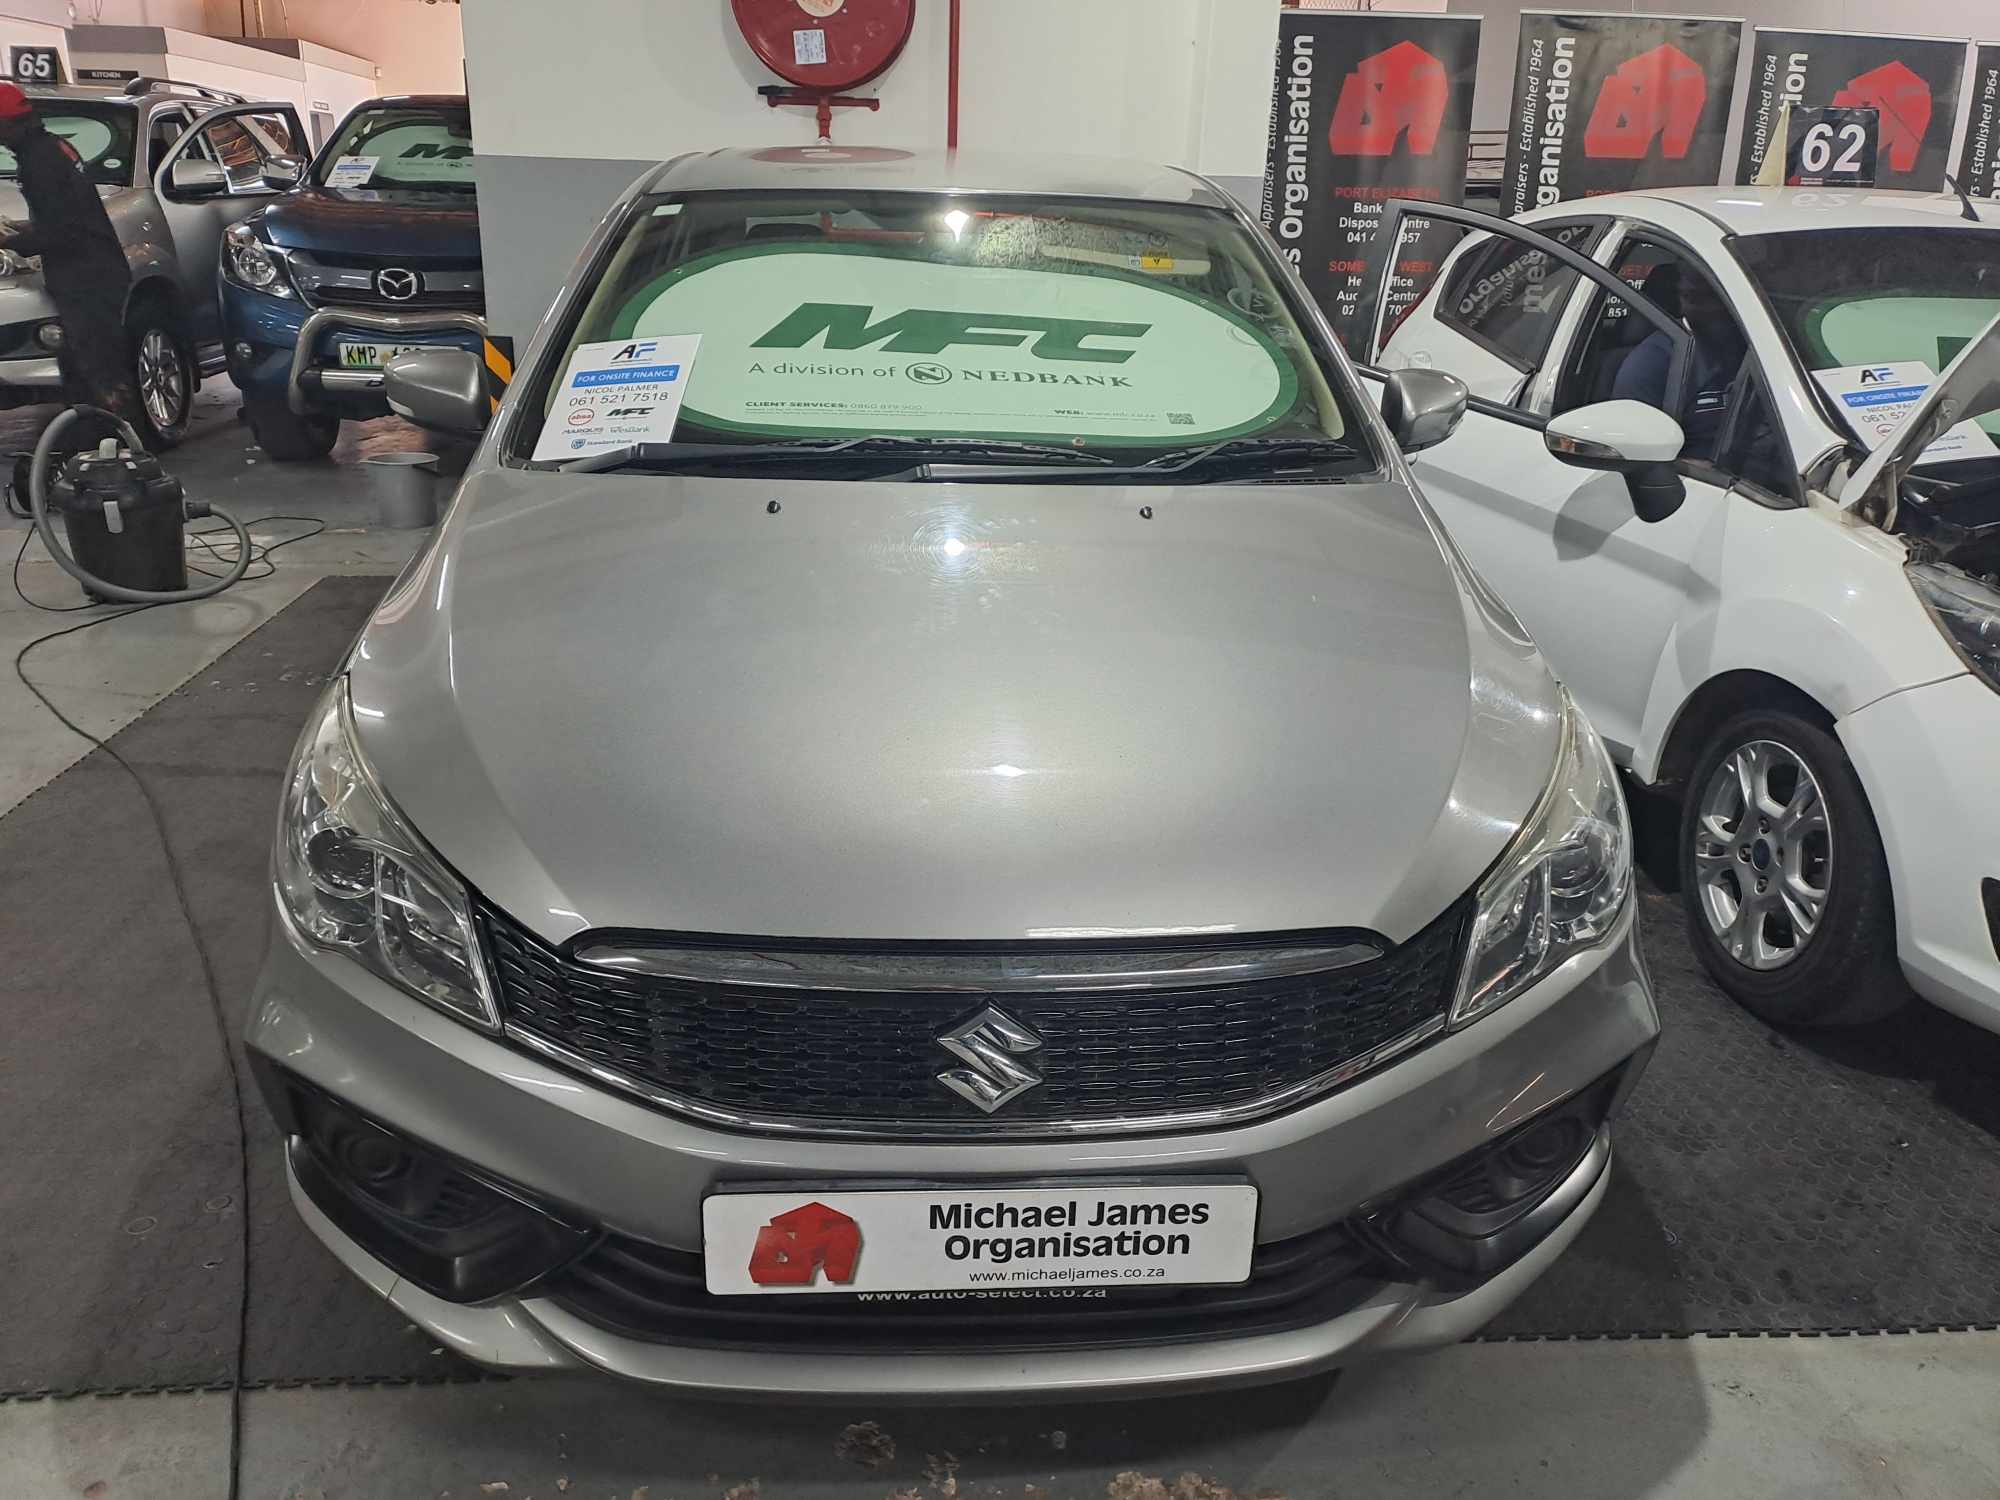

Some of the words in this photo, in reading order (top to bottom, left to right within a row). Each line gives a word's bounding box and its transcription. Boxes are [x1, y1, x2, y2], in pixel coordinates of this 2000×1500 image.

[18, 53, 51, 77] 65
[1529, 39, 1544, 73] 1964
[91, 71, 121, 79] KITCHEN
[1520, 75, 1539, 152] Established
[1751, 89, 1772, 163] Established
[1763, 54, 1778, 86] 1964
[1536, 37, 1576, 208] ganisation
[1971, 103, 1993, 174] Established
[1984, 69, 1999, 99] 1964
[1279, 34, 1314, 239] Organisation
[1802, 123, 1866, 172] 62
[1262, 162, 1276, 230] Appraisers
[1335, 187, 1368, 198] PORT
[1513, 163, 1529, 218] praisers
[1353, 202, 1383, 214] Bank
[1339, 217, 1379, 230] Dispos
[1347, 232, 1366, 242] 041
[1328, 260, 1366, 272] SOME
[1342, 305, 1355, 315] 02
[749, 302, 1153, 364] MFC
[612, 342, 657, 361] AF
[576, 375, 596, 384] FOR
[598, 373, 630, 382] ONSITE
[632, 370, 675, 380] FINANCE
[748, 362, 765, 374] A
[773, 362, 864, 377] division
[872, 366, 897, 377] of
[960, 369, 1133, 387] NEDBANK
[1860, 367, 1894, 384] AF
[584, 386, 616, 395] NICOL
[617, 384, 659, 393] PALMER
[569, 397, 596, 407] 061
[600, 394, 626, 404] 521
[632, 392, 669, 402] 7518
[605, 406, 657, 416] MFC
[1862, 413, 1887, 423] 061
[929, 1201, 1077, 1230] Michael
[1087, 1201, 1210, 1228] James
[944, 1230, 1190, 1264] Organisation
[969, 1265, 1166, 1283] www.michaeljames.co.za
